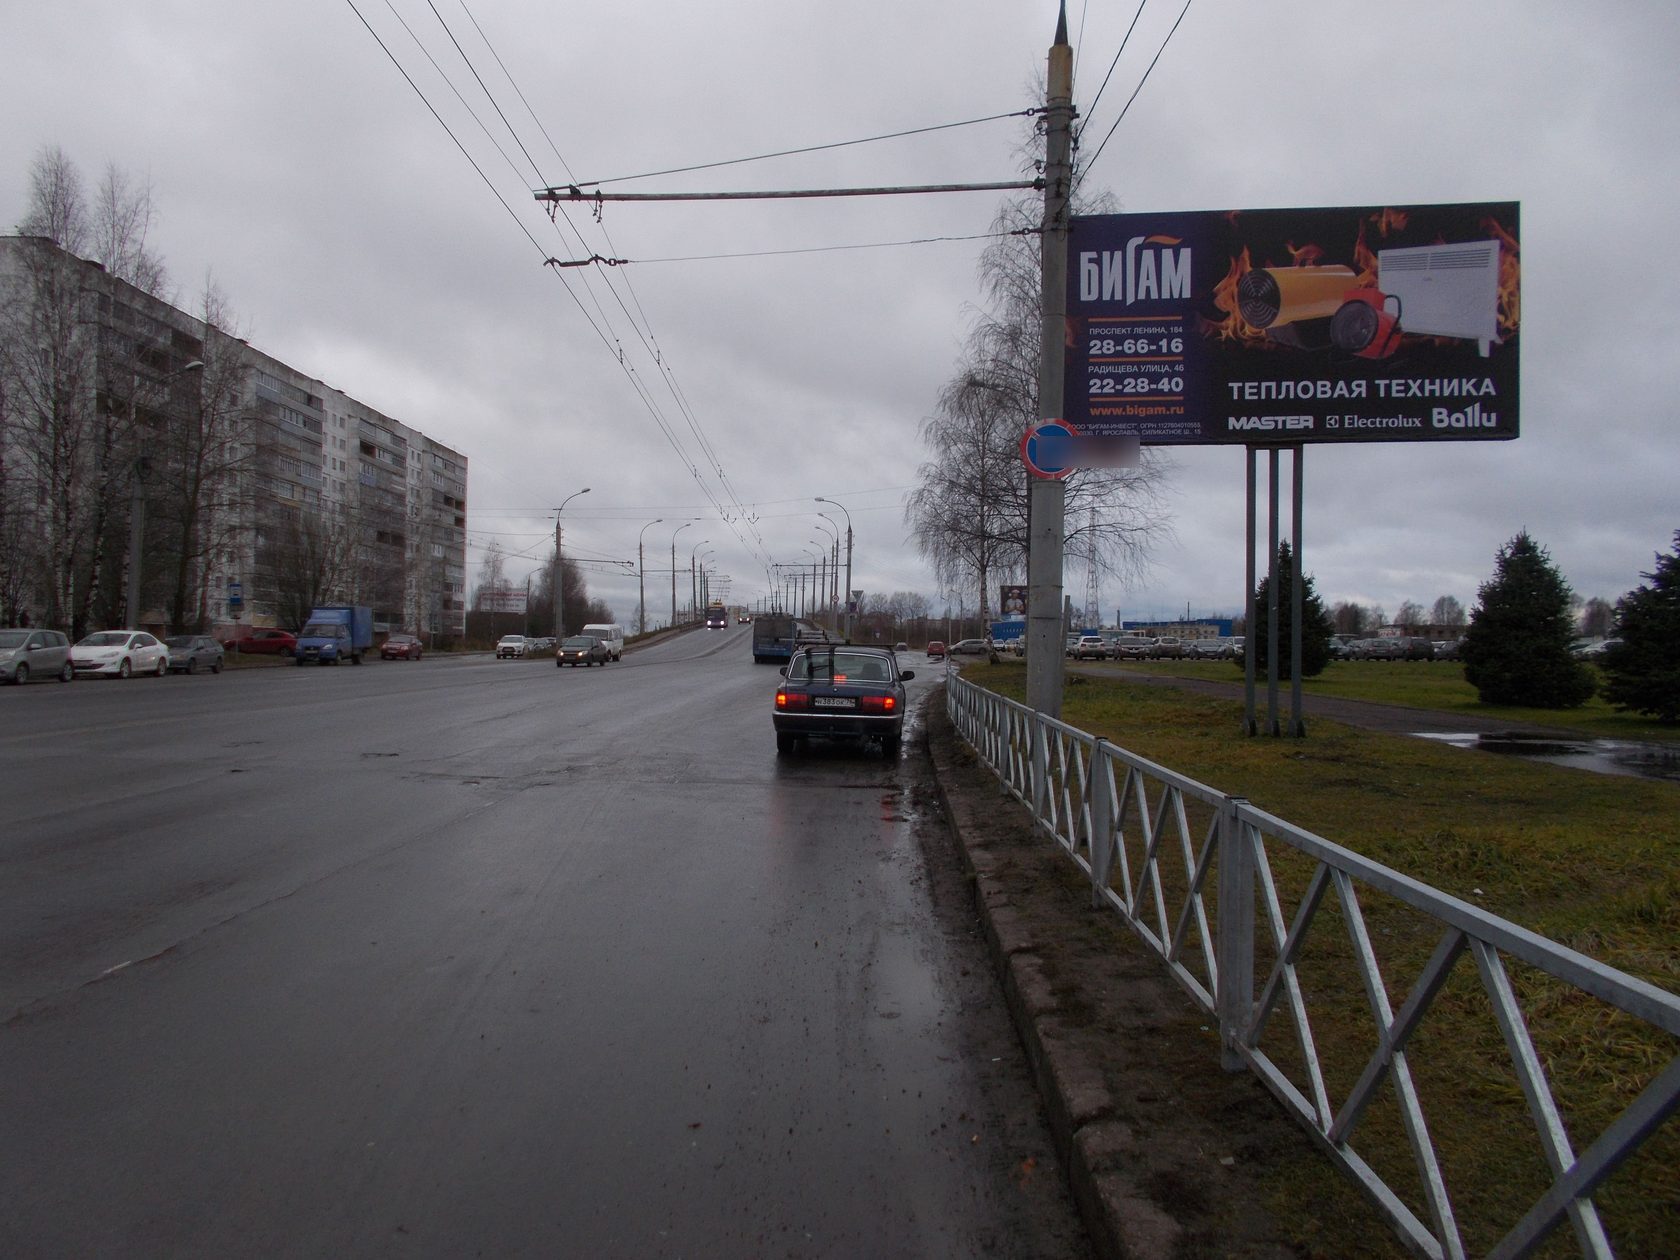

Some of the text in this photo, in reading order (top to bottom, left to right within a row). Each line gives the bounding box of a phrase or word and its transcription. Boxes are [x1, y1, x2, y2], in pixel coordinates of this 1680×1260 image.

[1080, 236, 1191, 306] БИГАМ
[1089, 327, 1131, 335] ПРОСПЕКТ
[1133, 327, 1168, 335] ЛЕНИНА,
[1089, 338, 1184, 354] 28-66-16
[1088, 365, 1139, 374] РАДИЩЕВА
[1140, 364, 1172, 373] УЛИЦА,
[1089, 377, 1184, 393] 22-28-40
[1228, 378, 1496, 400] ТЕПЛОВАЯ ТЕХНИКА
[1090, 405, 1184, 417] www.bigam.ru
[1432, 402, 1497, 428] Ballu
[1228, 416, 1314, 430] MASTER
[1344, 414, 1422, 428] Electrolux
